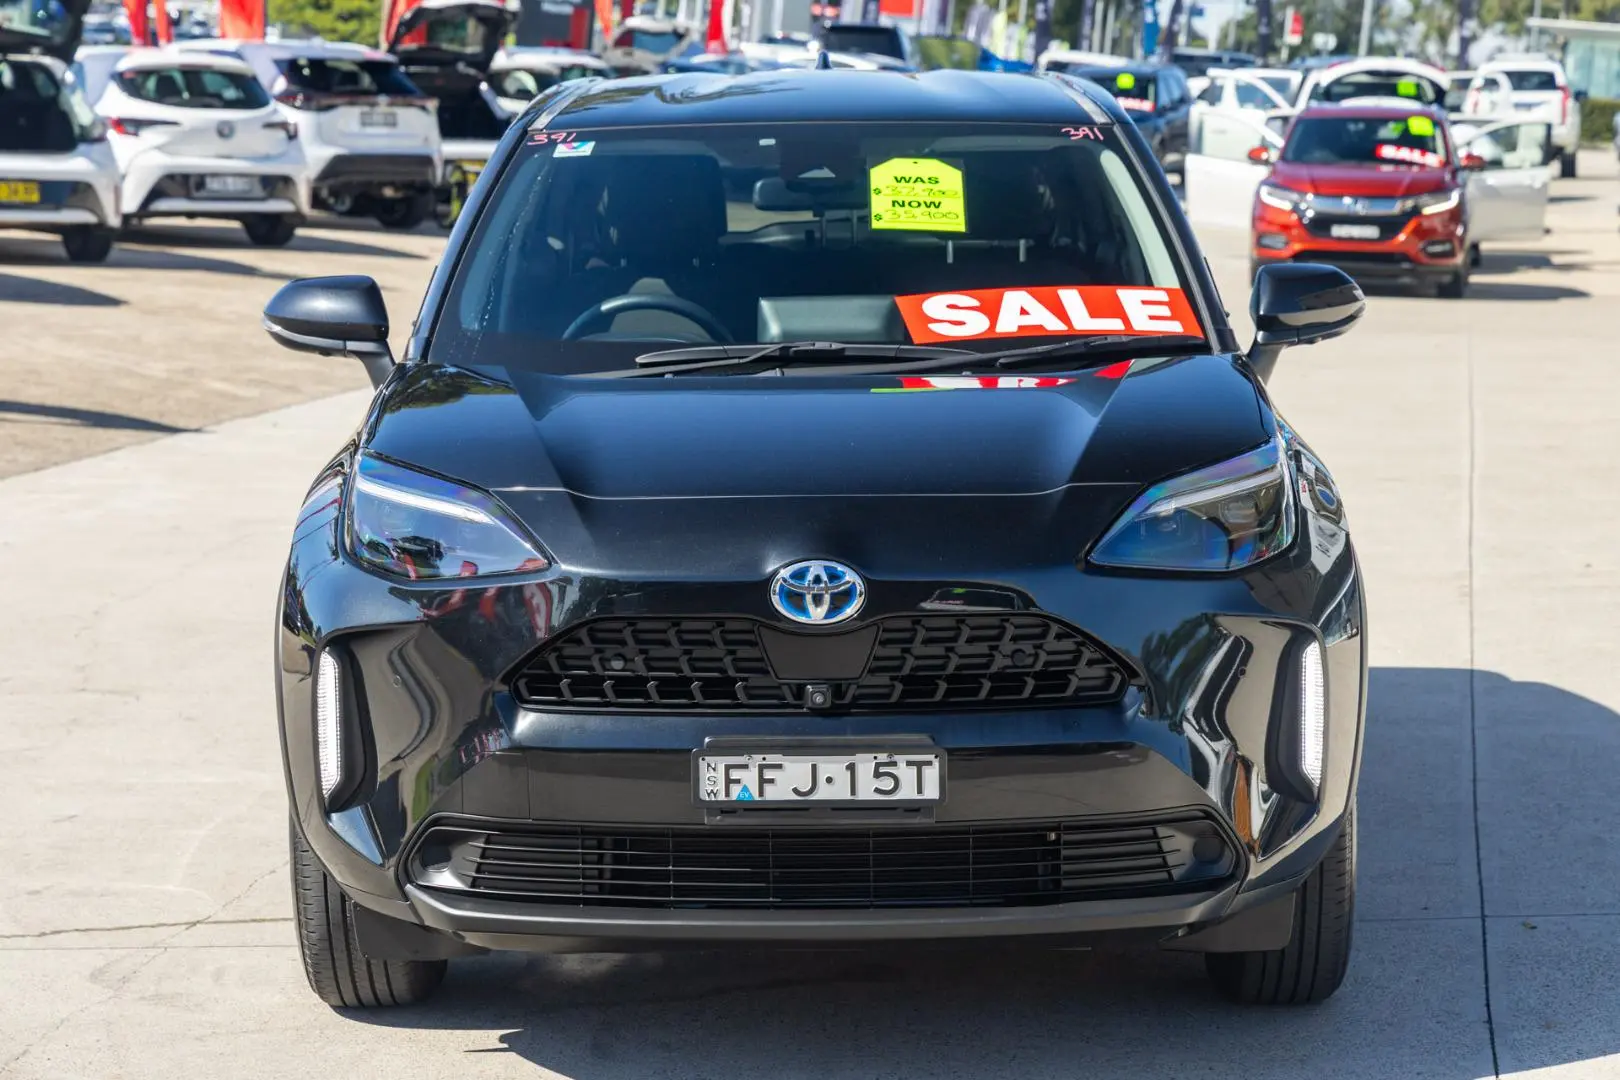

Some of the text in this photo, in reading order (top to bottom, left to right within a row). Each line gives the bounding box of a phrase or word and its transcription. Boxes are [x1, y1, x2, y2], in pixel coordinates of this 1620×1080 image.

[1061, 127, 1104, 141] 391
[893, 176, 940, 184] WAS
[891, 200, 942, 208] NOW
[921, 288, 1184, 337] SALE
[705, 762, 719, 799] NSW
